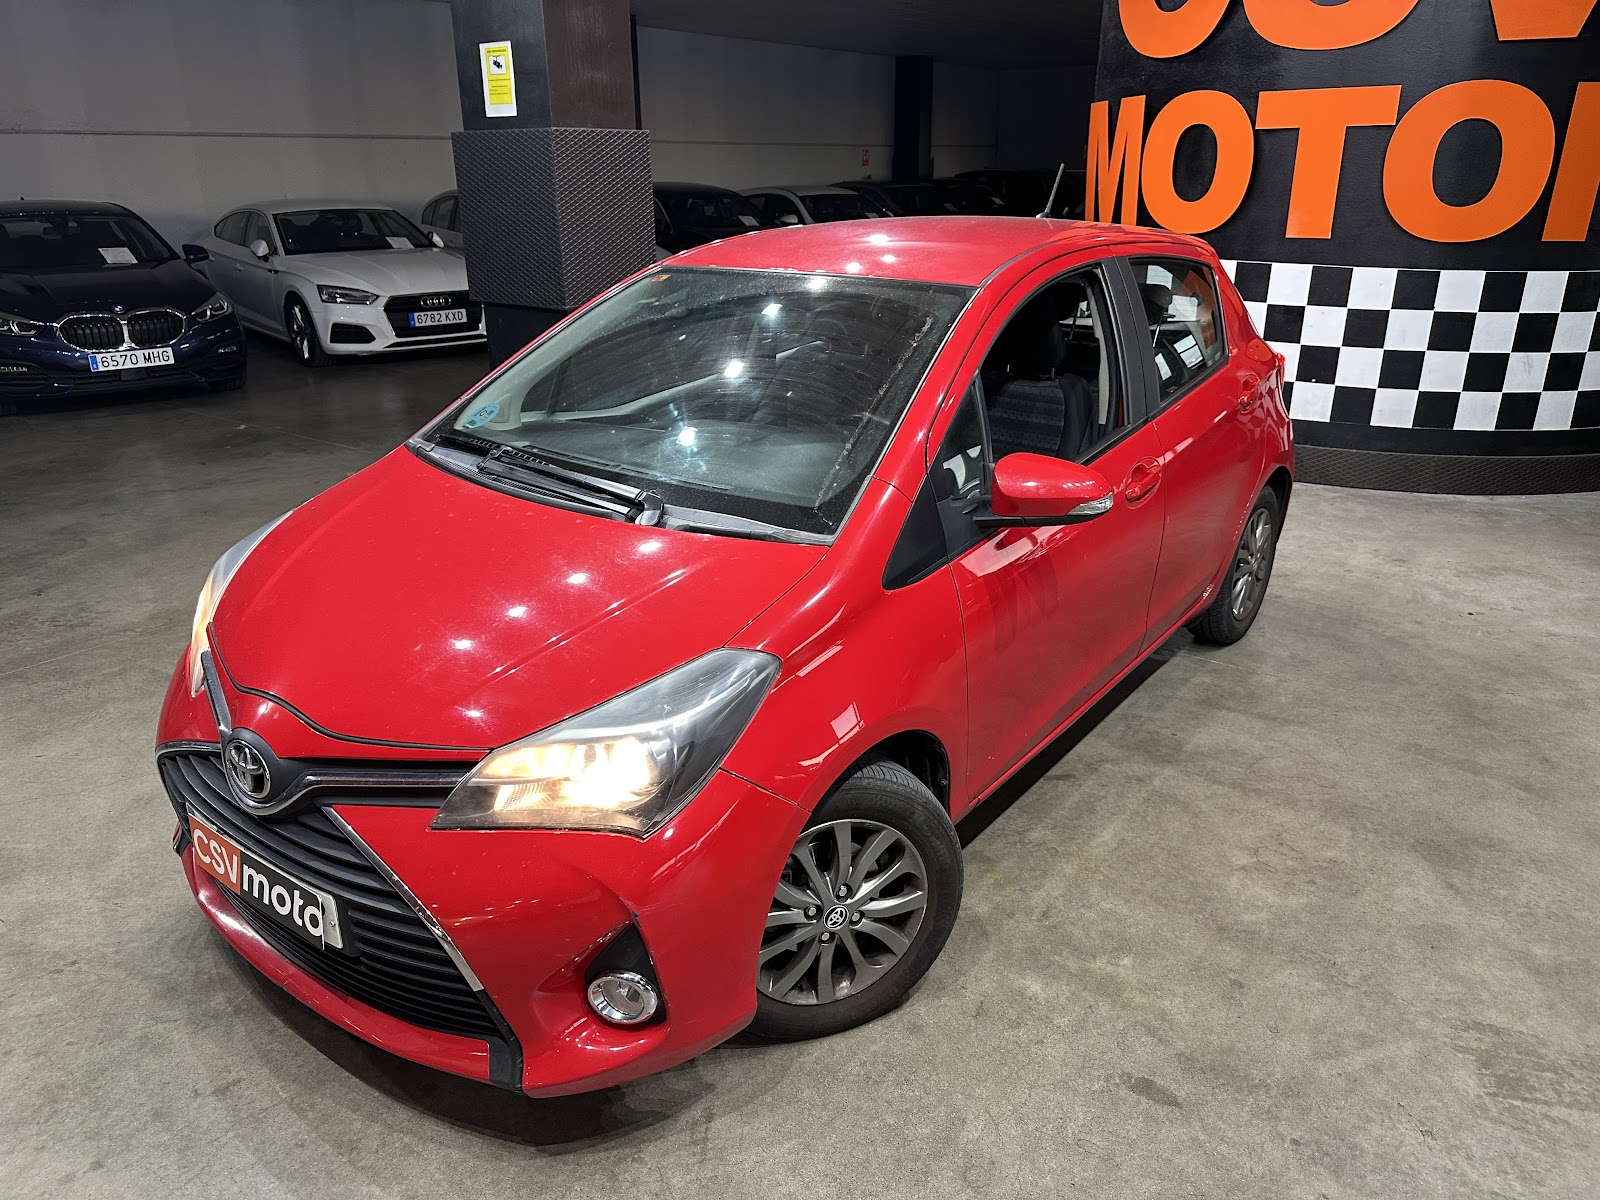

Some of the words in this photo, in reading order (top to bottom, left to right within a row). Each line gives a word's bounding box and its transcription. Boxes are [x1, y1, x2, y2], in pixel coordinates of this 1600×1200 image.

[416, 312, 442, 325] 6782
[445, 311, 464, 322] KXD
[101, 352, 138, 368] 6570
[143, 350, 170, 364] MHG
[193, 828, 237, 884] CSV
